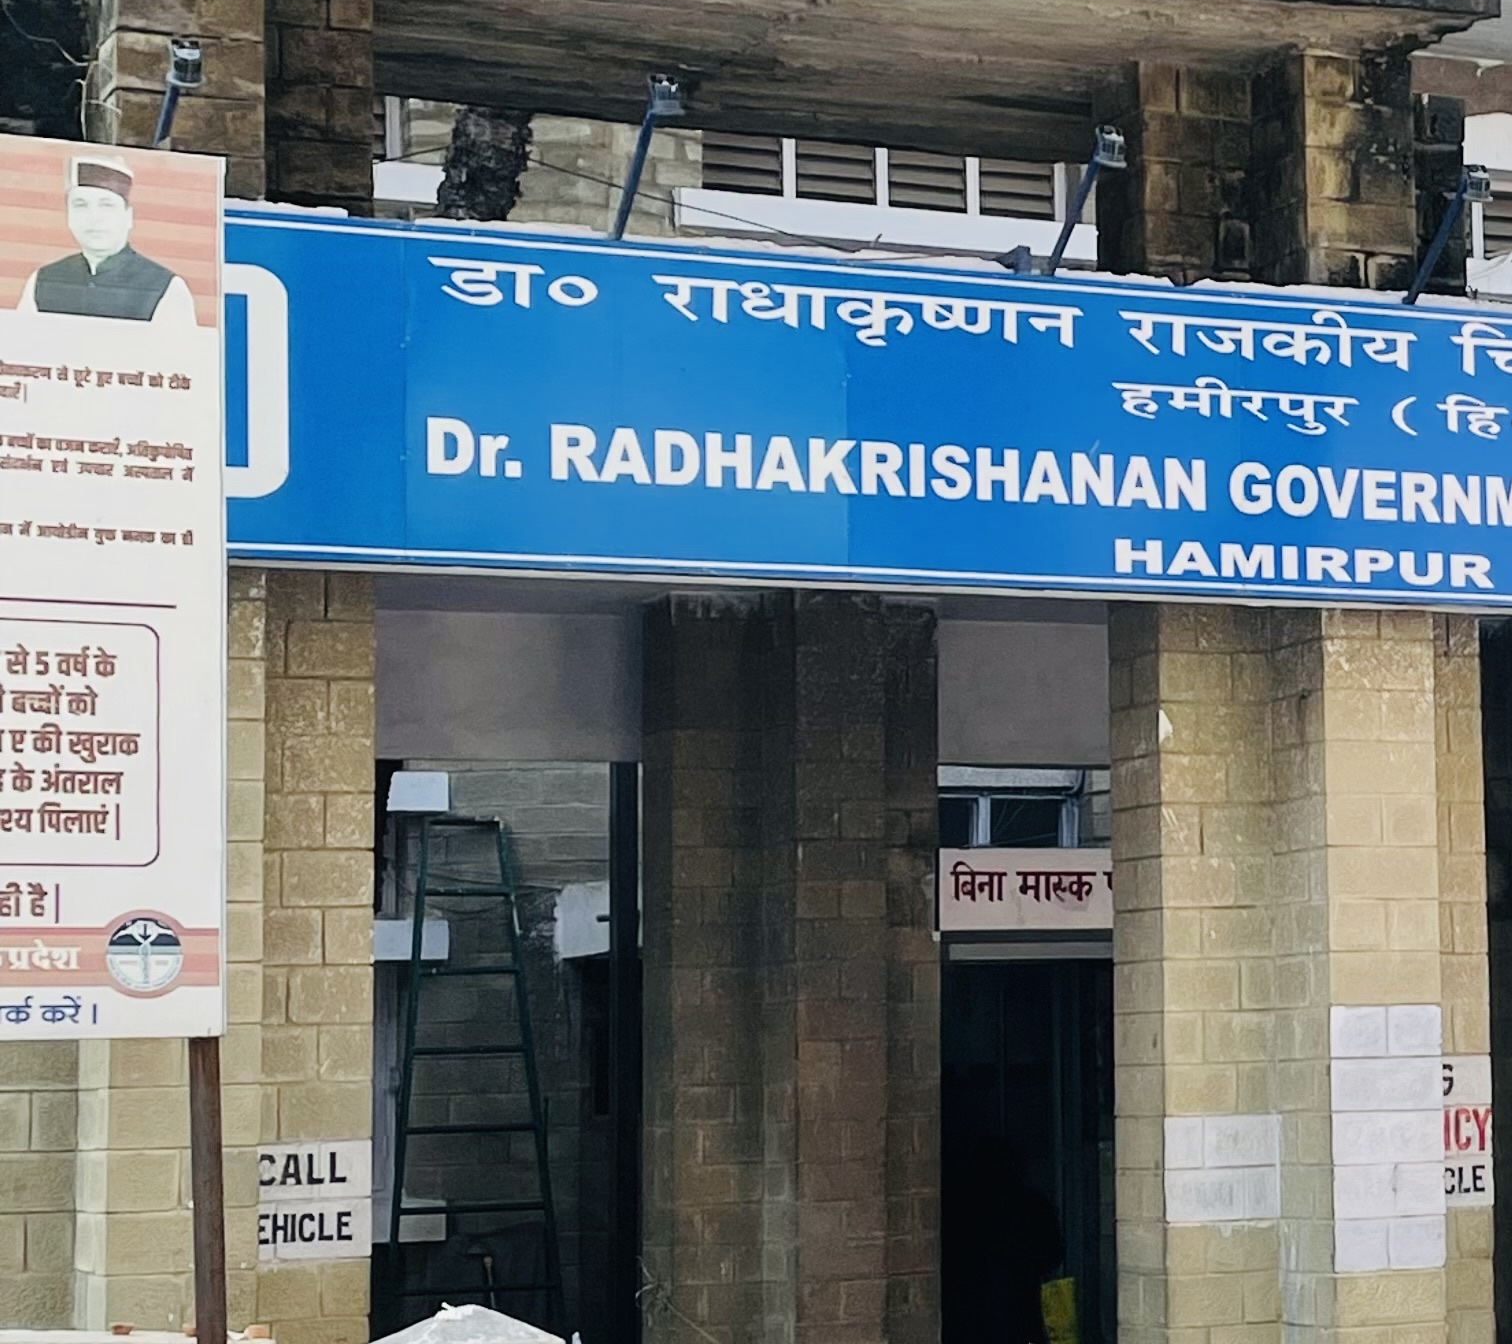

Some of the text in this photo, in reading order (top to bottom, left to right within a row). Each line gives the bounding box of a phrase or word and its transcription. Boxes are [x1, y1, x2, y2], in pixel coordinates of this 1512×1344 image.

[1118, 310, 1418, 371] राजकीय
[1113, 377, 1358, 434] हमीरपुर
[427, 417, 521, 477] Dr.
[551, 424, 1206, 510] RADHAKRISHANAN
[1115, 539, 1494, 588] HAMIRPUR
[5, 643, 117, 677] से 5 वर्ष के
[10, 683, 98, 716] बच्चों को
[30, 722, 62, 754] की
[66, 731, 141, 764] खुराक
[10, 761, 124, 794] के अंतराल
[950, 861, 1007, 901] बिना
[1016, 871, 1096, 902] मास्क
[259, 1152, 347, 1186] CALL
[258, 1211, 353, 1245] EHICLE
